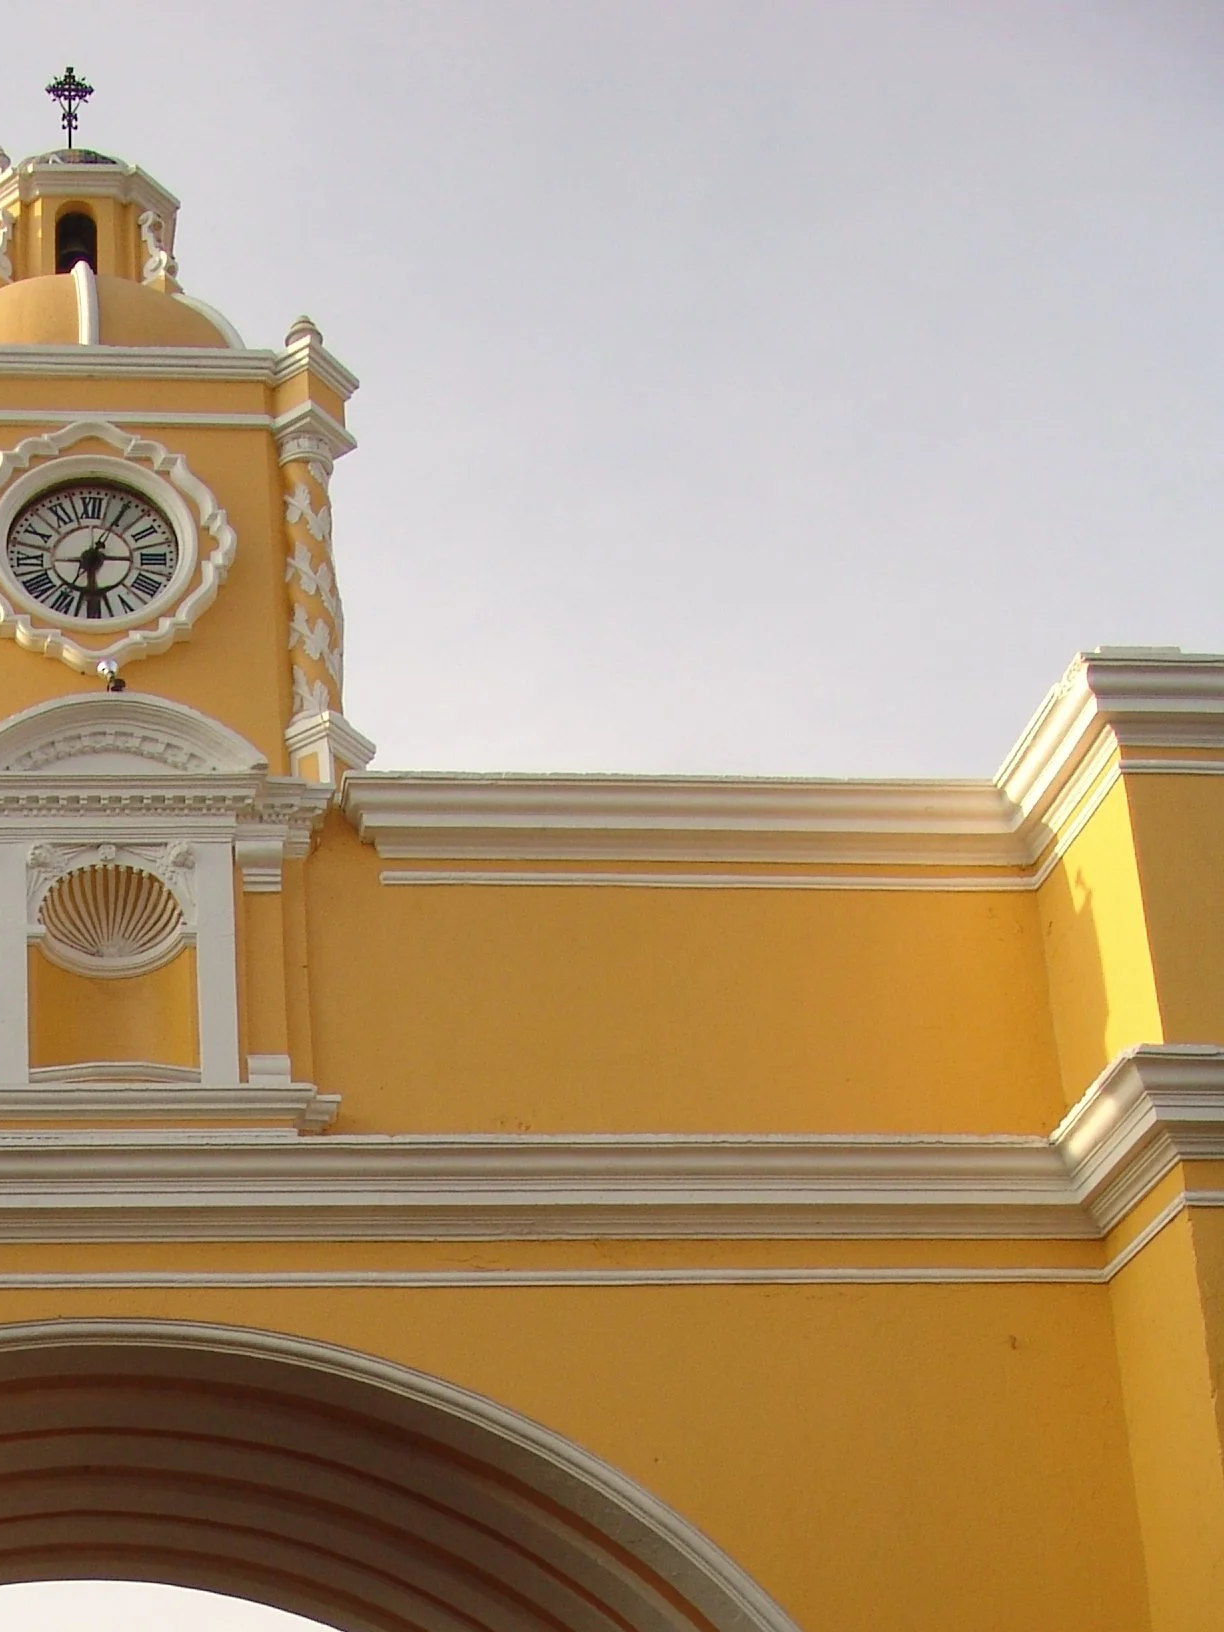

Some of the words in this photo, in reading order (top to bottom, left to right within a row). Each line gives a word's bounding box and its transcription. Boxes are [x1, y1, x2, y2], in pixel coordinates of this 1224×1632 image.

[48, 502, 74, 528] XI
[80, 496, 104, 519] XII
[25, 524, 52, 544] X
[131, 525, 157, 543] II
[17, 551, 44, 568] IX
[140, 552, 167, 566] III
[117, 594, 134, 614] V
